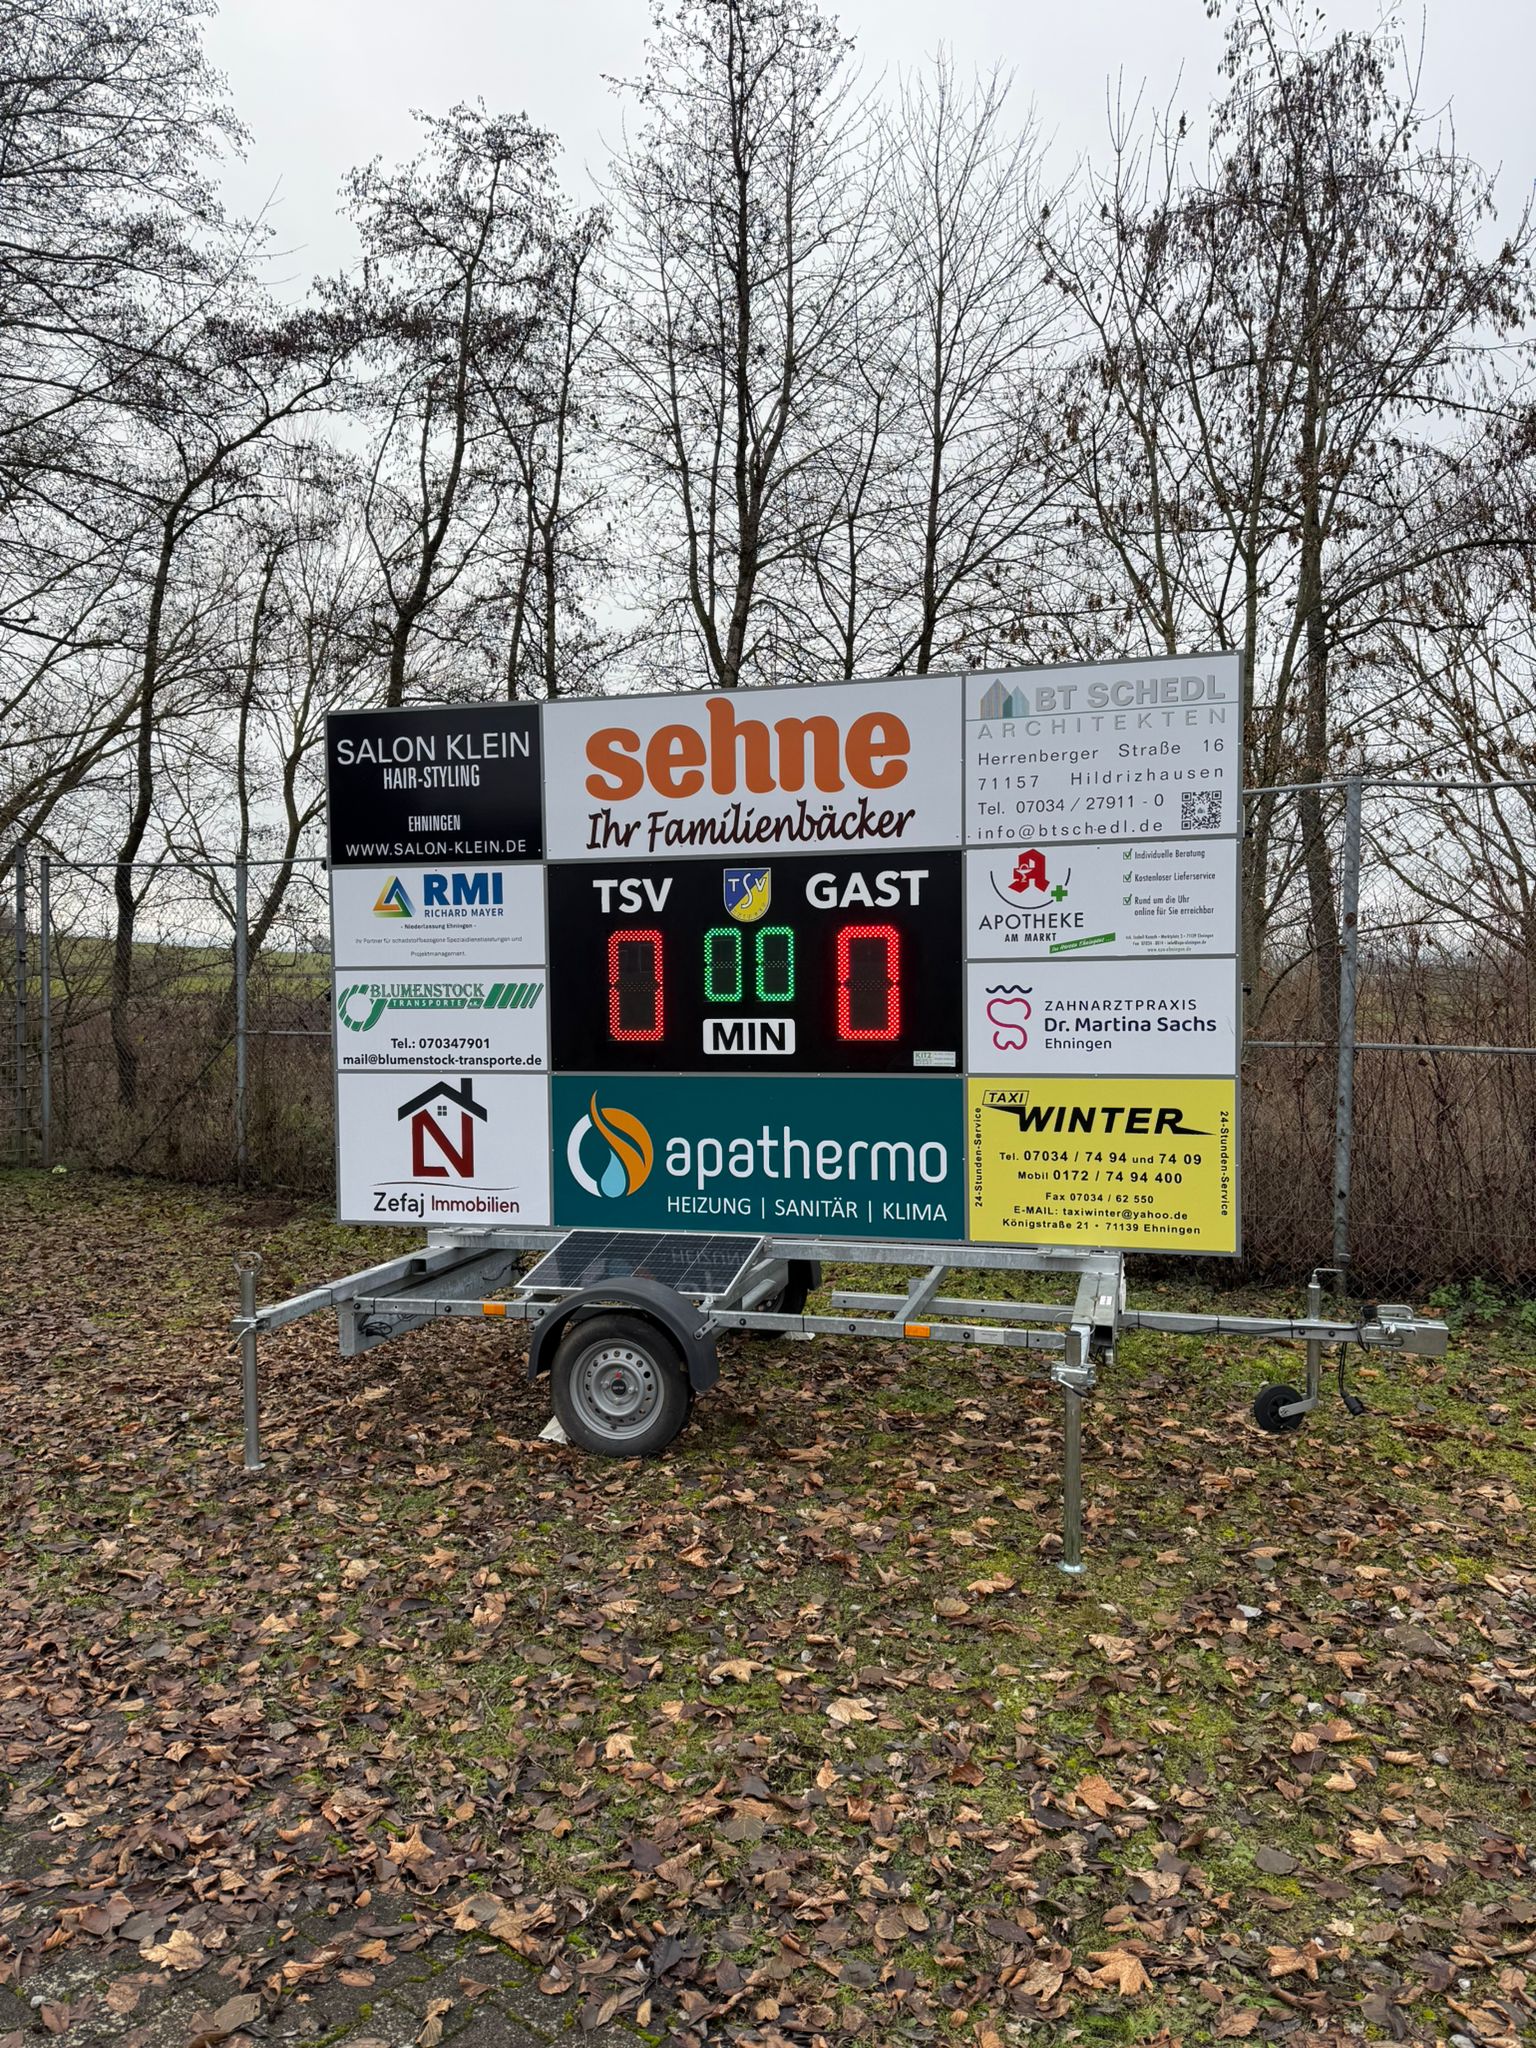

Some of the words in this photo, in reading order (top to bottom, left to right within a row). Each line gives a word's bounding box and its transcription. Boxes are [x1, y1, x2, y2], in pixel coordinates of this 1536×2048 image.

[1035, 685, 1077, 712] BT
[1087, 674, 1226, 709] SCHEDL
[978, 707, 1226, 740] ARCHITEKTEN
[336, 735, 436, 766] SALON
[446, 731, 530, 761] KLEIN
[585, 697, 911, 802] sehne
[978, 748, 1100, 767] Herrenberger
[1118, 741, 1181, 758] Straße
[1203, 738, 1225, 752] 16
[383, 764, 480, 790] HAIR-STYLING
[978, 775, 1039, 791] 71157
[1071, 767, 1224, 786] Hildrizhausen
[978, 802, 1006, 816] Tel.
[1016, 799, 1065, 813] 07034
[1086, 796, 1134, 811] 27911
[408, 815, 461, 832] EHNINGEN
[586, 808, 641, 850] Ihr
[647, 796, 916, 853] Familienbäcker
[978, 819, 1163, 840] info@btschedl.de
[346, 839, 526, 857] WWW.SALON-KLEIN.DE
[1135, 850, 1173, 859] Individuelle
[1175, 849, 1206, 859] Beratung
[1134, 872, 1172, 882] Kostenloser
[1174, 871, 1216, 881] Lieferservice
[423, 872, 504, 906] RMI
[592, 877, 673, 913] TSV
[805, 869, 929, 909] GAST
[1134, 895, 1151, 905] Rund
[1165, 895, 1176, 904] die
[1178, 894, 1190, 903] Uhr
[424, 909, 468, 918] RICHARD
[471, 908, 504, 917] MAYER
[1134, 907, 1155, 916] online
[1157, 906, 1166, 915] für
[1168, 906, 1178, 915] Sie
[1180, 905, 1214, 915] erreichbar
[979, 912, 1085, 931] APOTHEKE
[1004, 933, 1021, 943] AM
[1025, 932, 1057, 942] MARKT
[370, 983, 485, 998] BLUMENSTOCK
[608, 929, 664, 1041] 0
[837, 925, 901, 1041] 0
[1045, 998, 1197, 1011] ZAHNARZTPRAXIS
[1044, 1017, 1070, 1032] Dr.
[1075, 1016, 1151, 1032] Martina
[1157, 1016, 1217, 1032] Sachs
[391, 1038, 416, 1049] Tel.:
[419, 1038, 490, 1049] 070347901
[712, 1022, 787, 1051] MIN
[1045, 1038, 1112, 1052] Ehningen
[343, 1054, 542, 1068] mail@blumenstock-transporte.de
[989, 1092, 1025, 1104] TAXI
[1018, 1106, 1200, 1136] WINTER
[665, 1125, 948, 1191] apathermo
[974, 1107, 983, 1207] 24-Stunden-Service
[999, 1152, 1019, 1161] Tel.
[1024, 1150, 1068, 1162] 07034
[1085, 1151, 1103, 1163] 74
[1109, 1152, 1127, 1163] 94
[1133, 1155, 1154, 1164] und
[1159, 1153, 1177, 1164] 74
[1183, 1154, 1202, 1165] 09
[1220, 1110, 1230, 1216] 24-Stunden-Service
[1018, 1171, 1049, 1180] Mobil
[1053, 1170, 1089, 1181] 0172
[1106, 1171, 1123, 1182] 74
[1130, 1171, 1148, 1183] 94
[1155, 1172, 1183, 1184] 400
[373, 1192, 425, 1218] Zefaj
[431, 1195, 520, 1213] Immobilien
[667, 1196, 751, 1216] HEIZUNG
[774, 1194, 858, 1219] SANITÄR
[882, 1202, 948, 1222] KLIMA
[1046, 1192, 1065, 1201] Fax
[1070, 1193, 1103, 1202] 07034
[1116, 1194, 1129, 1203] 62
[1133, 1194, 1154, 1204] 550
[1014, 1206, 1058, 1216] E-MAIL:
[1062, 1207, 1188, 1220] taxiwinter@yahoo.de
[1002, 1218, 1072, 1230] Königstraße
[1077, 1221, 1089, 1230] 21
[1106, 1222, 1139, 1232] 71139
[1143, 1224, 1201, 1236] Ehningen
